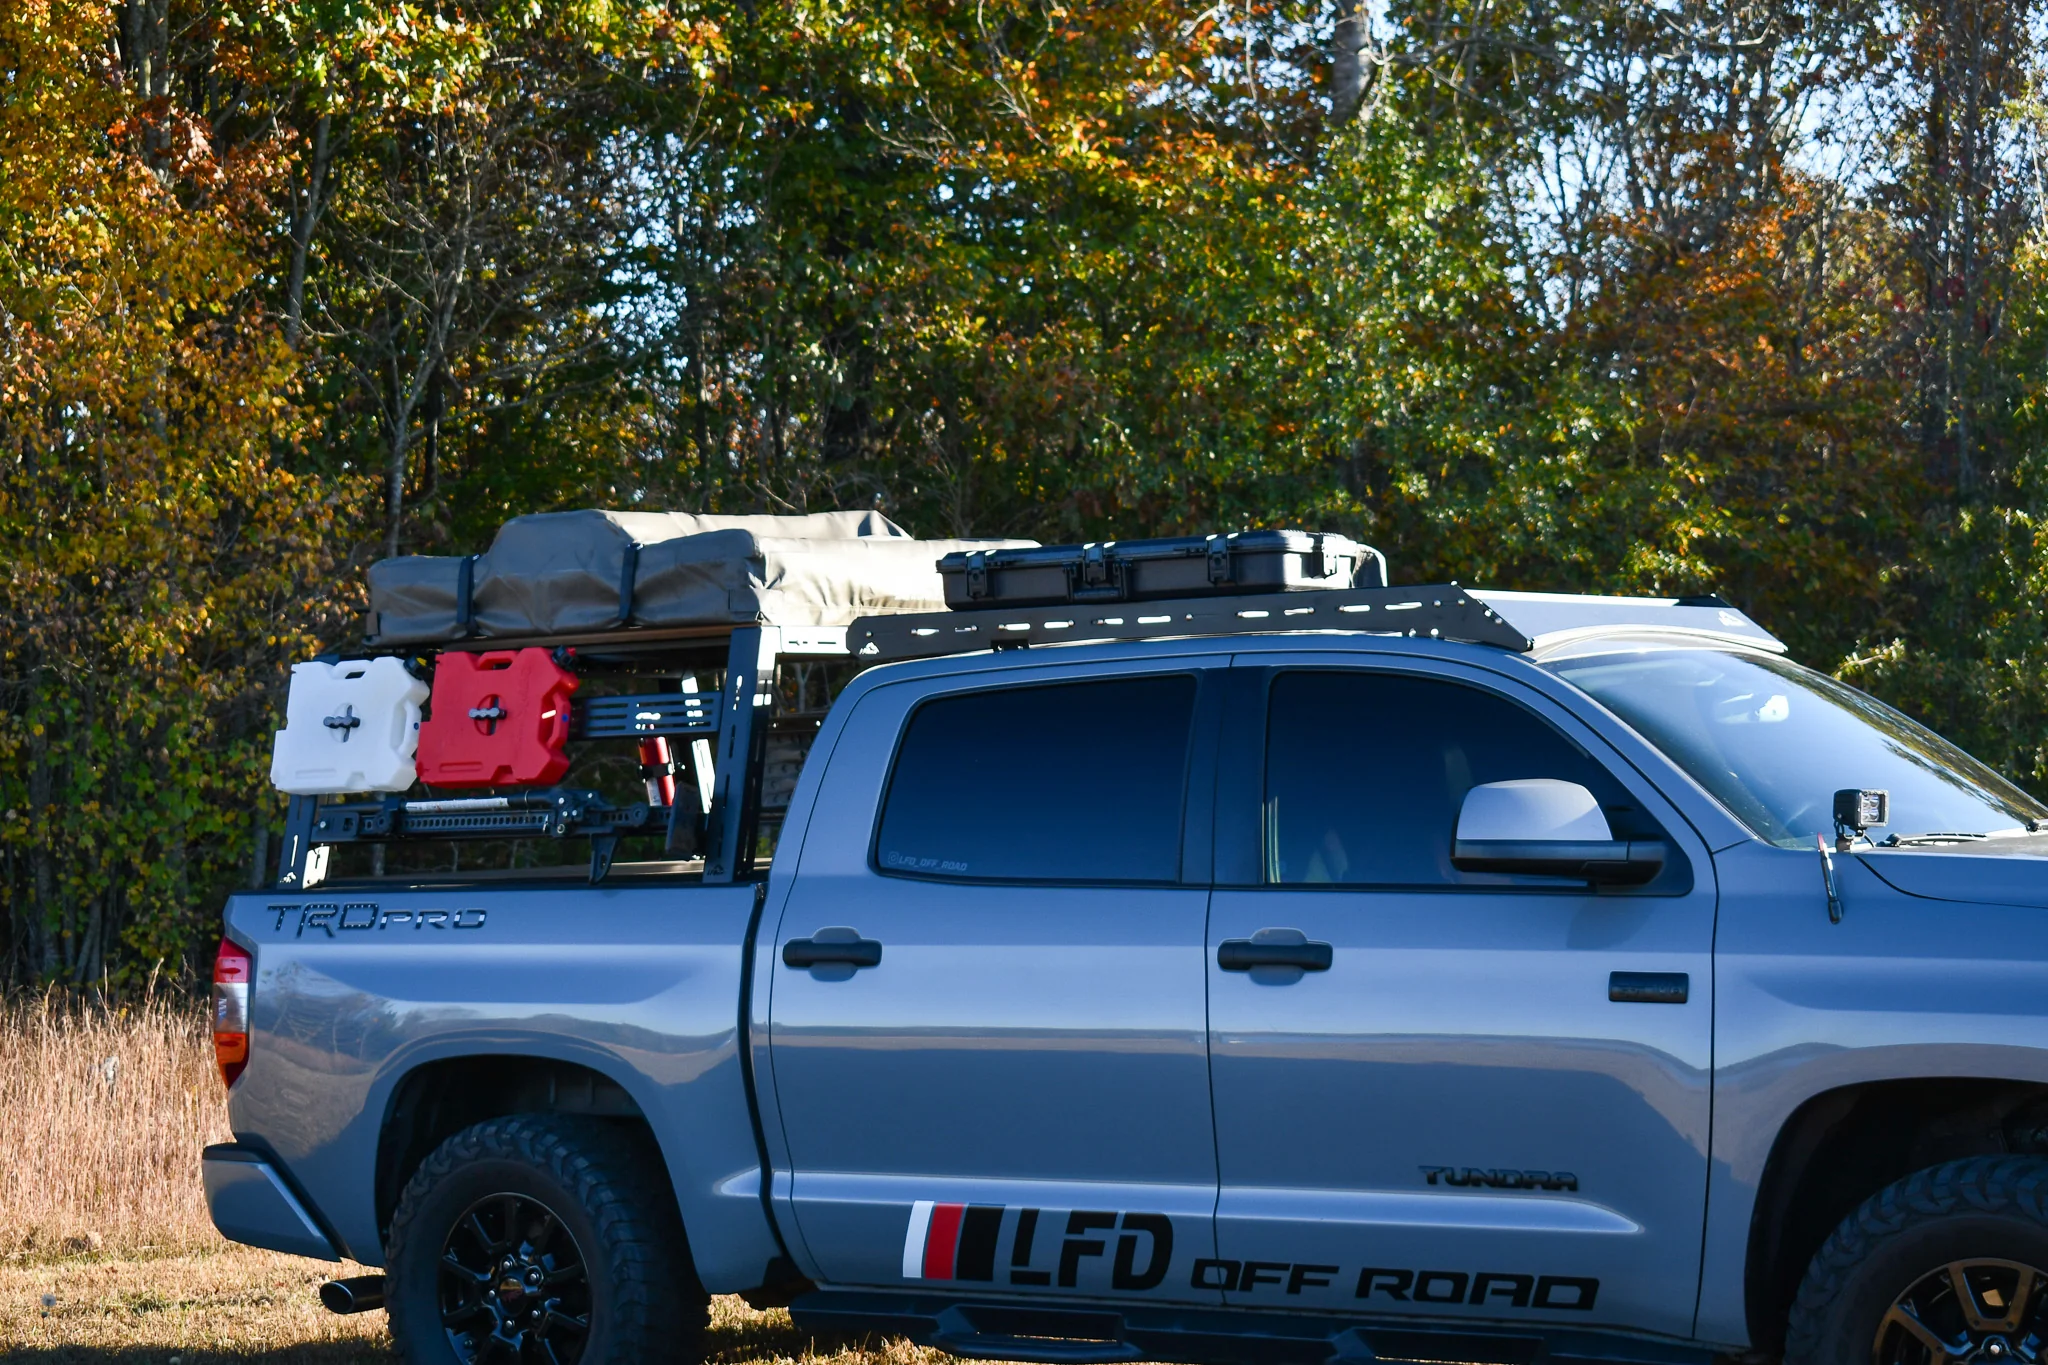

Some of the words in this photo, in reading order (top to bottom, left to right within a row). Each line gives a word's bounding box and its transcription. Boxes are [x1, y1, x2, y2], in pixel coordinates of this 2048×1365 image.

[267, 902, 379, 939] TRD
[379, 908, 487, 930] PRO
[1418, 1165, 1578, 1192] TUNDRA
[1010, 1208, 1174, 1290] LFD
[1190, 1258, 1340, 1294] OFF
[1355, 1267, 1600, 1310] ROAD
